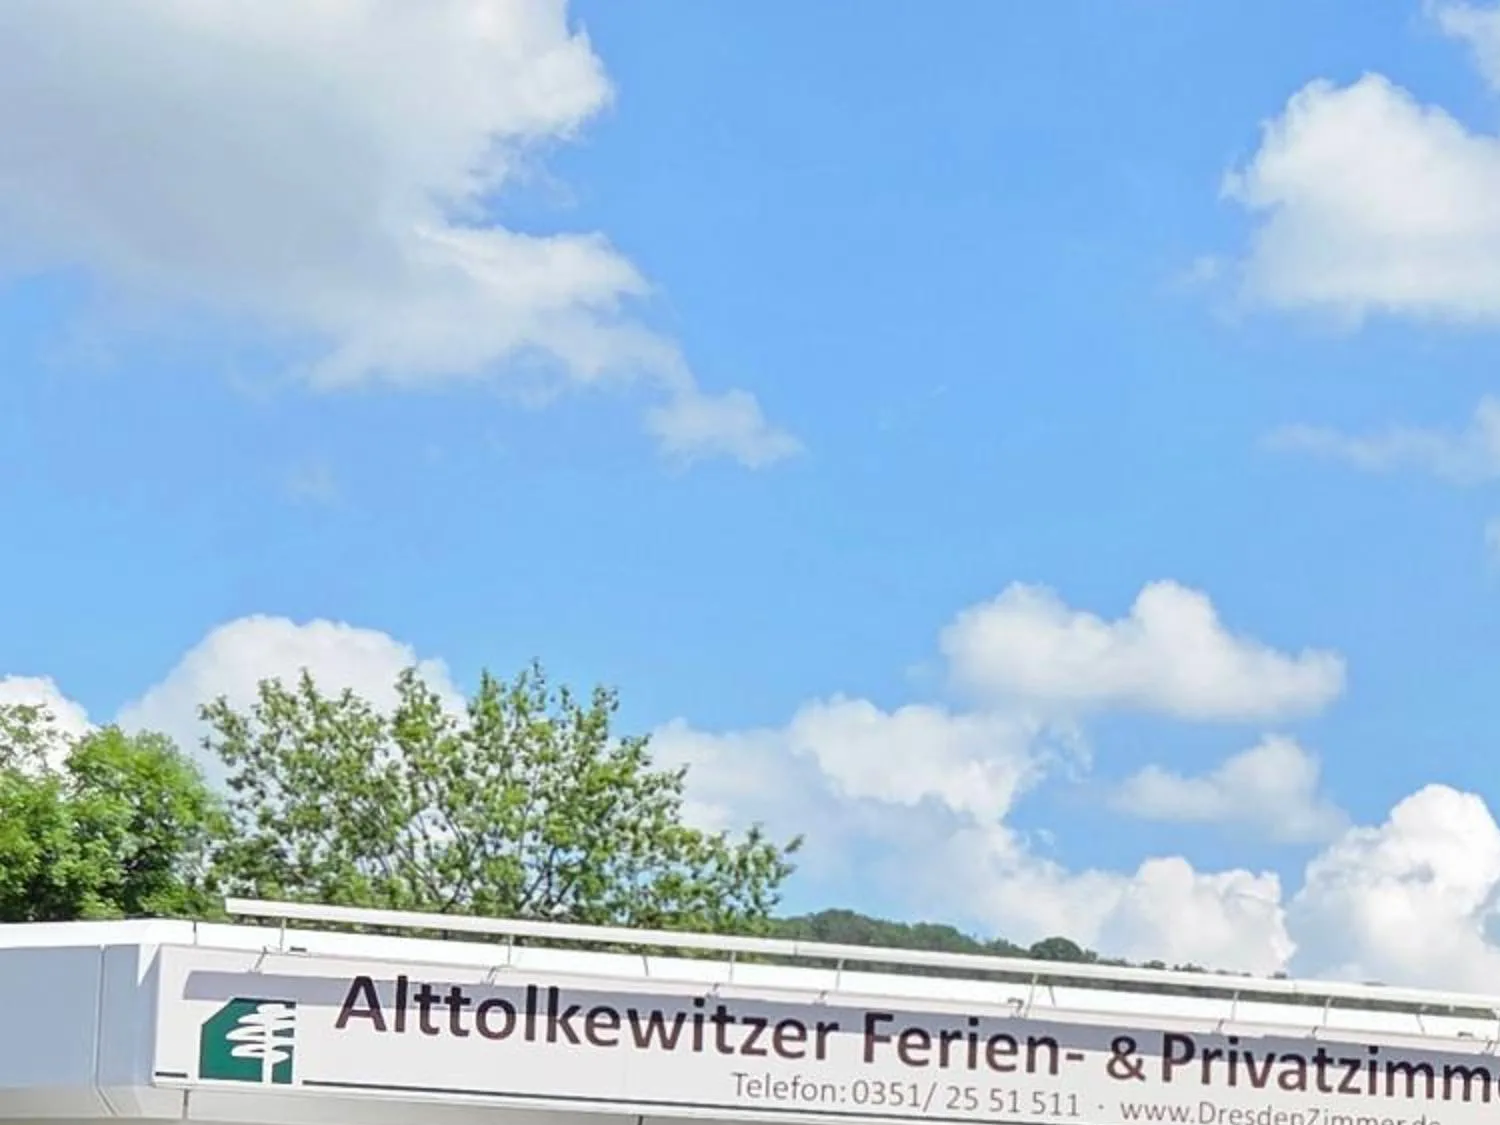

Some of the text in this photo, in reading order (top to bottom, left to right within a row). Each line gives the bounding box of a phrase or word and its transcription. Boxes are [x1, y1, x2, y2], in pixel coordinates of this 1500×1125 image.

[335, 975, 839, 1060] Alttolkewitzer
[863, 1012, 1084, 1075] Ferien-
[1106, 1035, 1146, 1081] &
